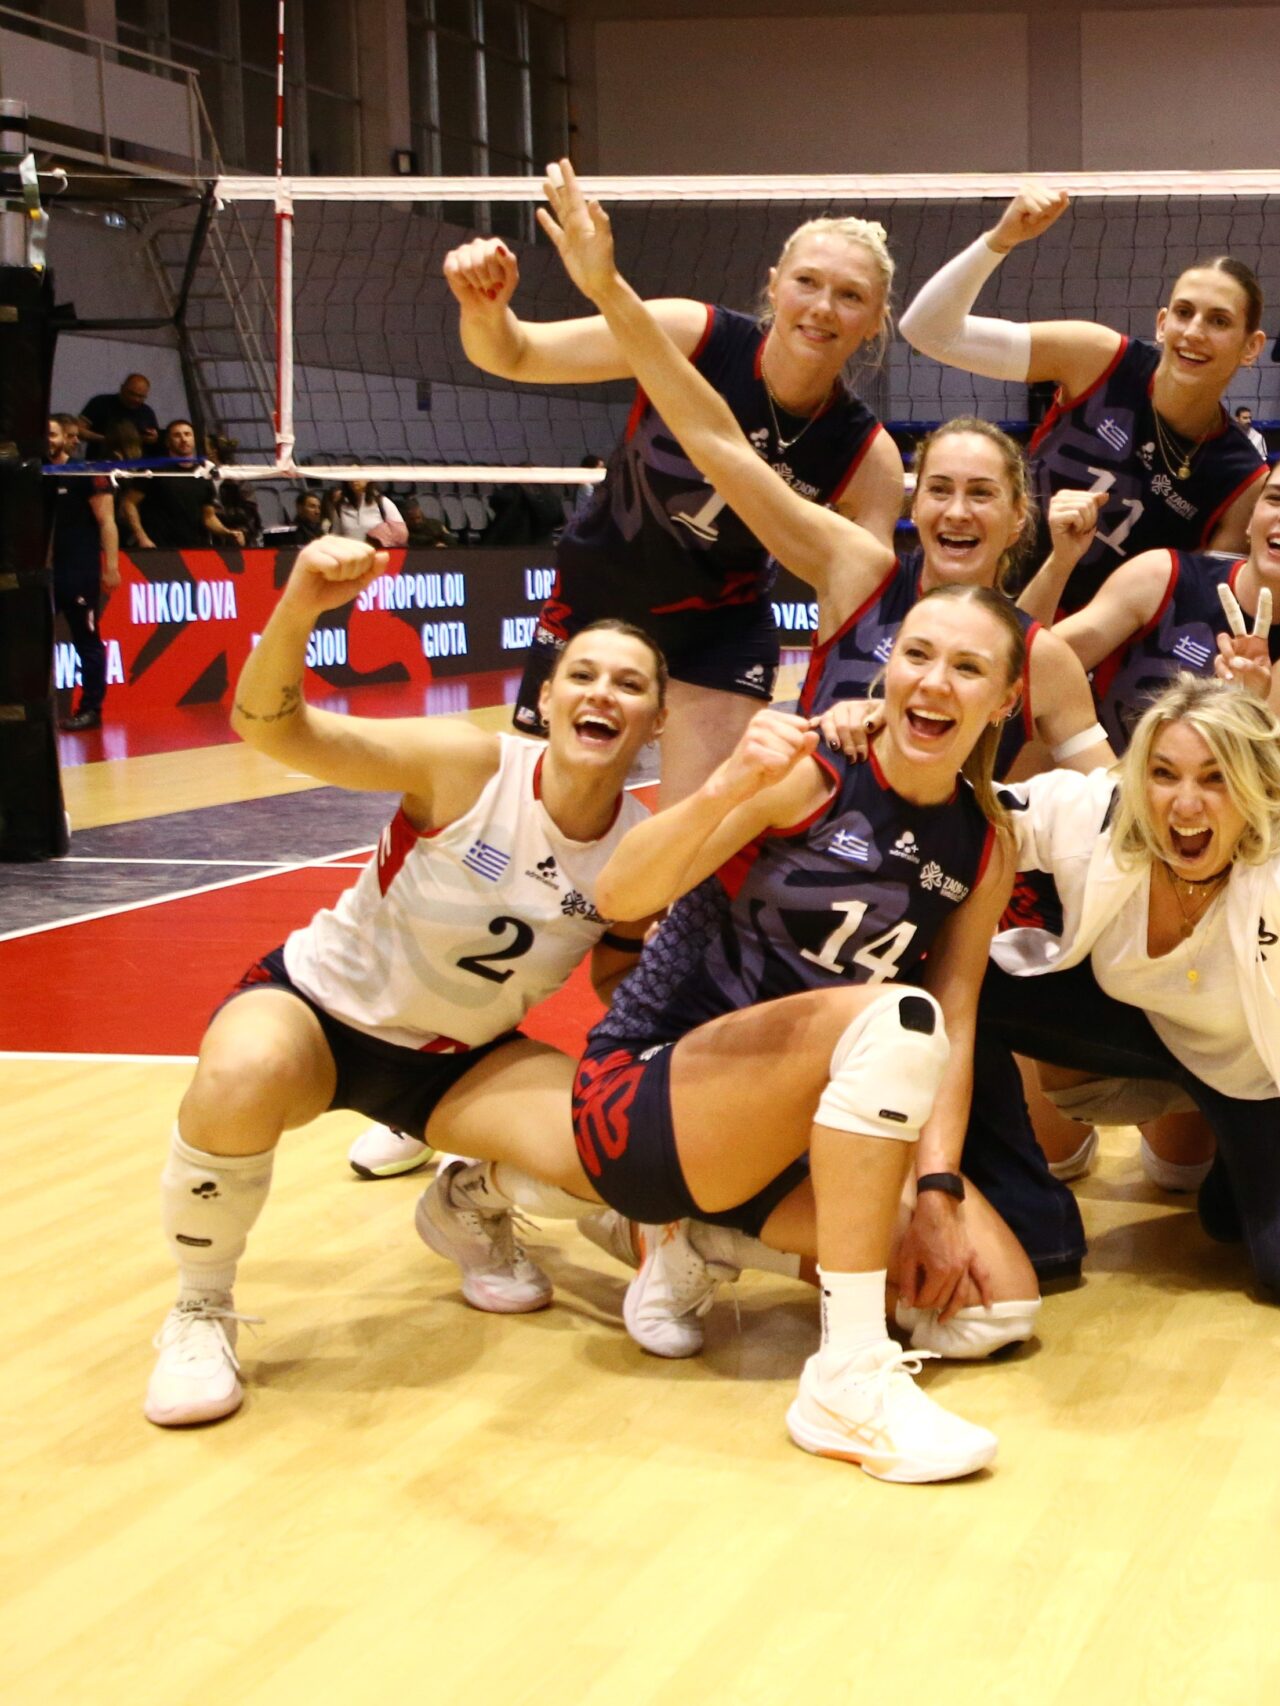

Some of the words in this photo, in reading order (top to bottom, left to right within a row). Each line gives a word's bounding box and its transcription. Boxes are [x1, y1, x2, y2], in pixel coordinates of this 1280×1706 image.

[131, 580, 237, 624] NIKOLOVA
[357, 573, 465, 612] SPIROPOULOU
[423, 622, 467, 658] GIOTA
[503, 616, 541, 650] ALEX
[456, 915, 535, 984] 2
[800, 900, 918, 985] 14
